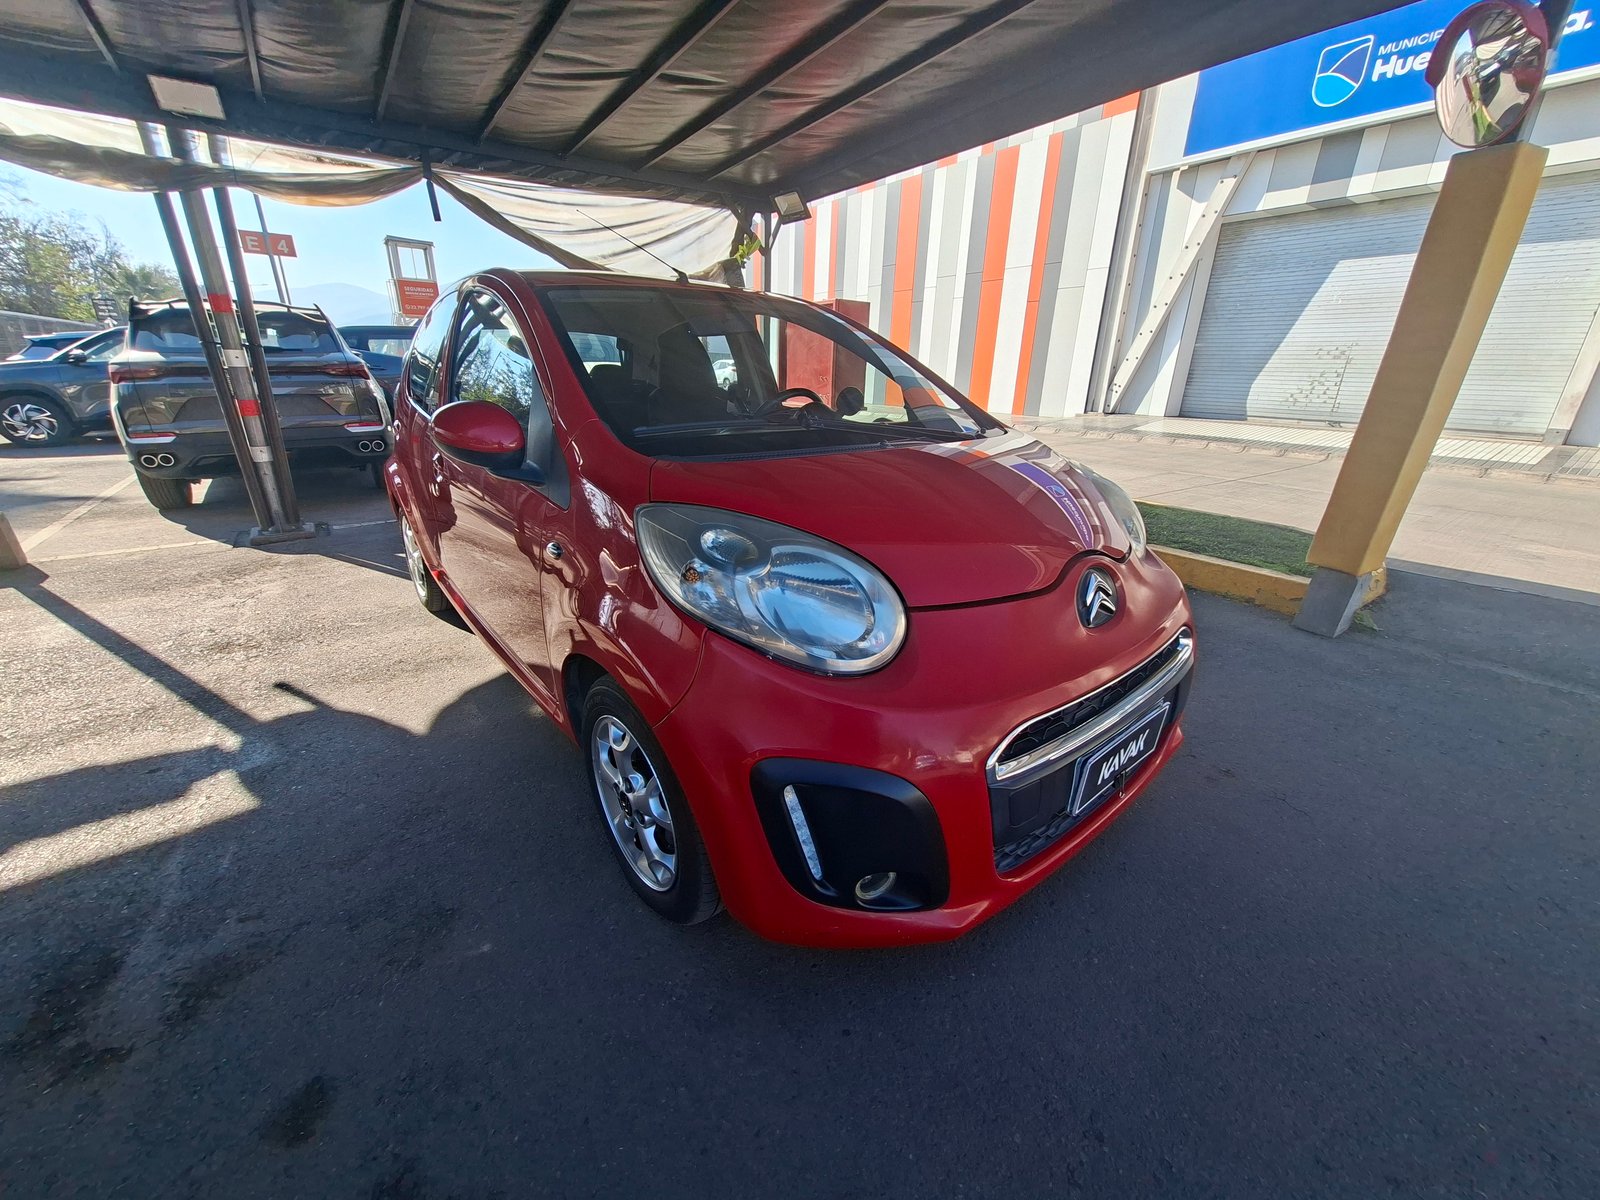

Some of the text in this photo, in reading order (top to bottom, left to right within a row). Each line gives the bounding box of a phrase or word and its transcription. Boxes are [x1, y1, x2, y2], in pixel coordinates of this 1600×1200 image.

[1378, 29, 1445, 56] MUNICIP
[1371, 51, 1432, 83] Hue
[245, 235, 289, 254] E 4
[1097, 728, 1150, 786] KAVAK
